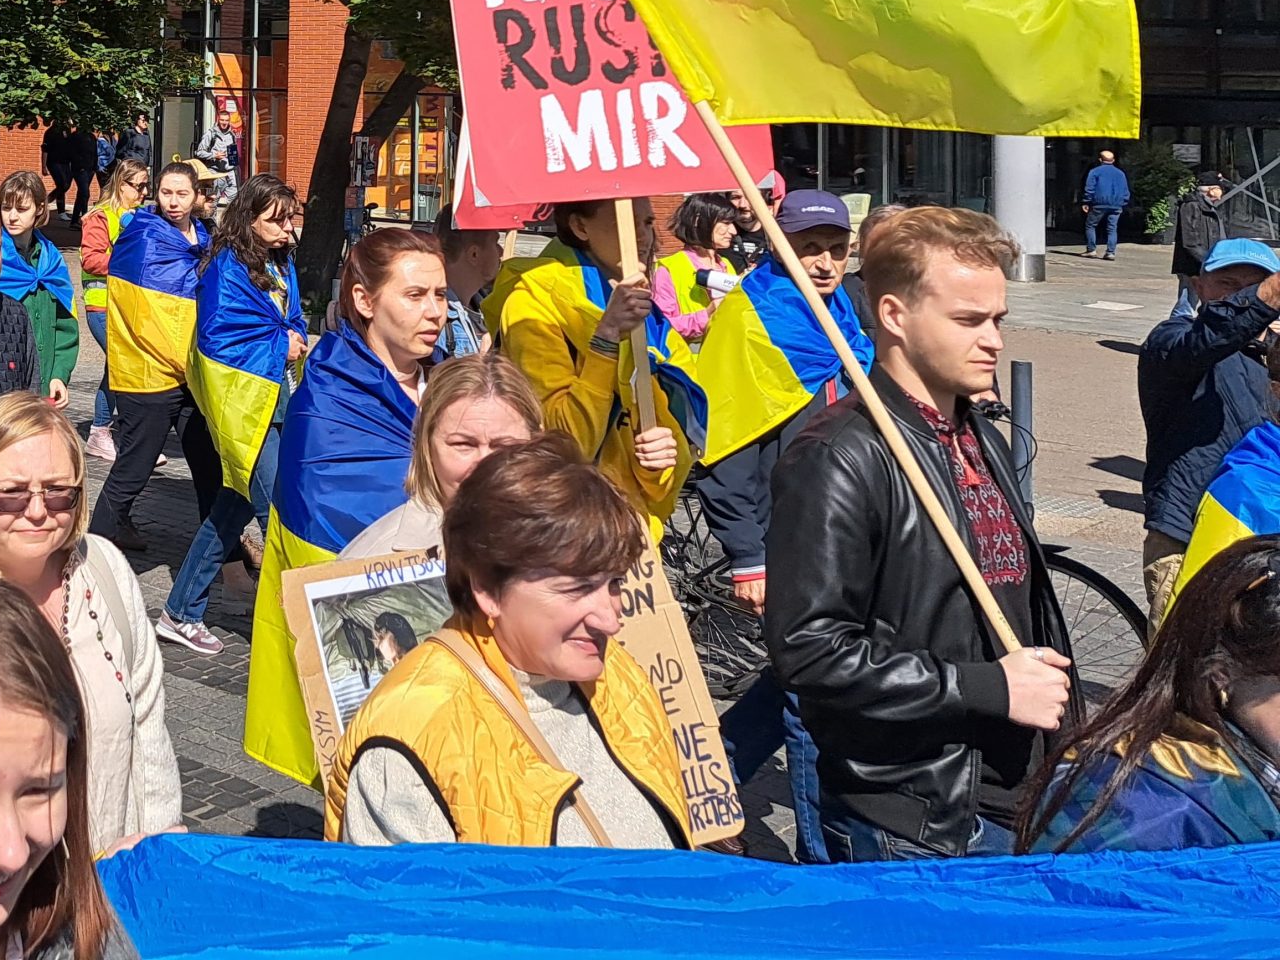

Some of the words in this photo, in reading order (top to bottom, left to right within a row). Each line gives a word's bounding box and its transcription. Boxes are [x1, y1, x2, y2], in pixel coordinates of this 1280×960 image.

[540, 80, 701, 173] MIR
[801, 206, 836, 214] HEAD
[315, 710, 337, 771] KSYM
